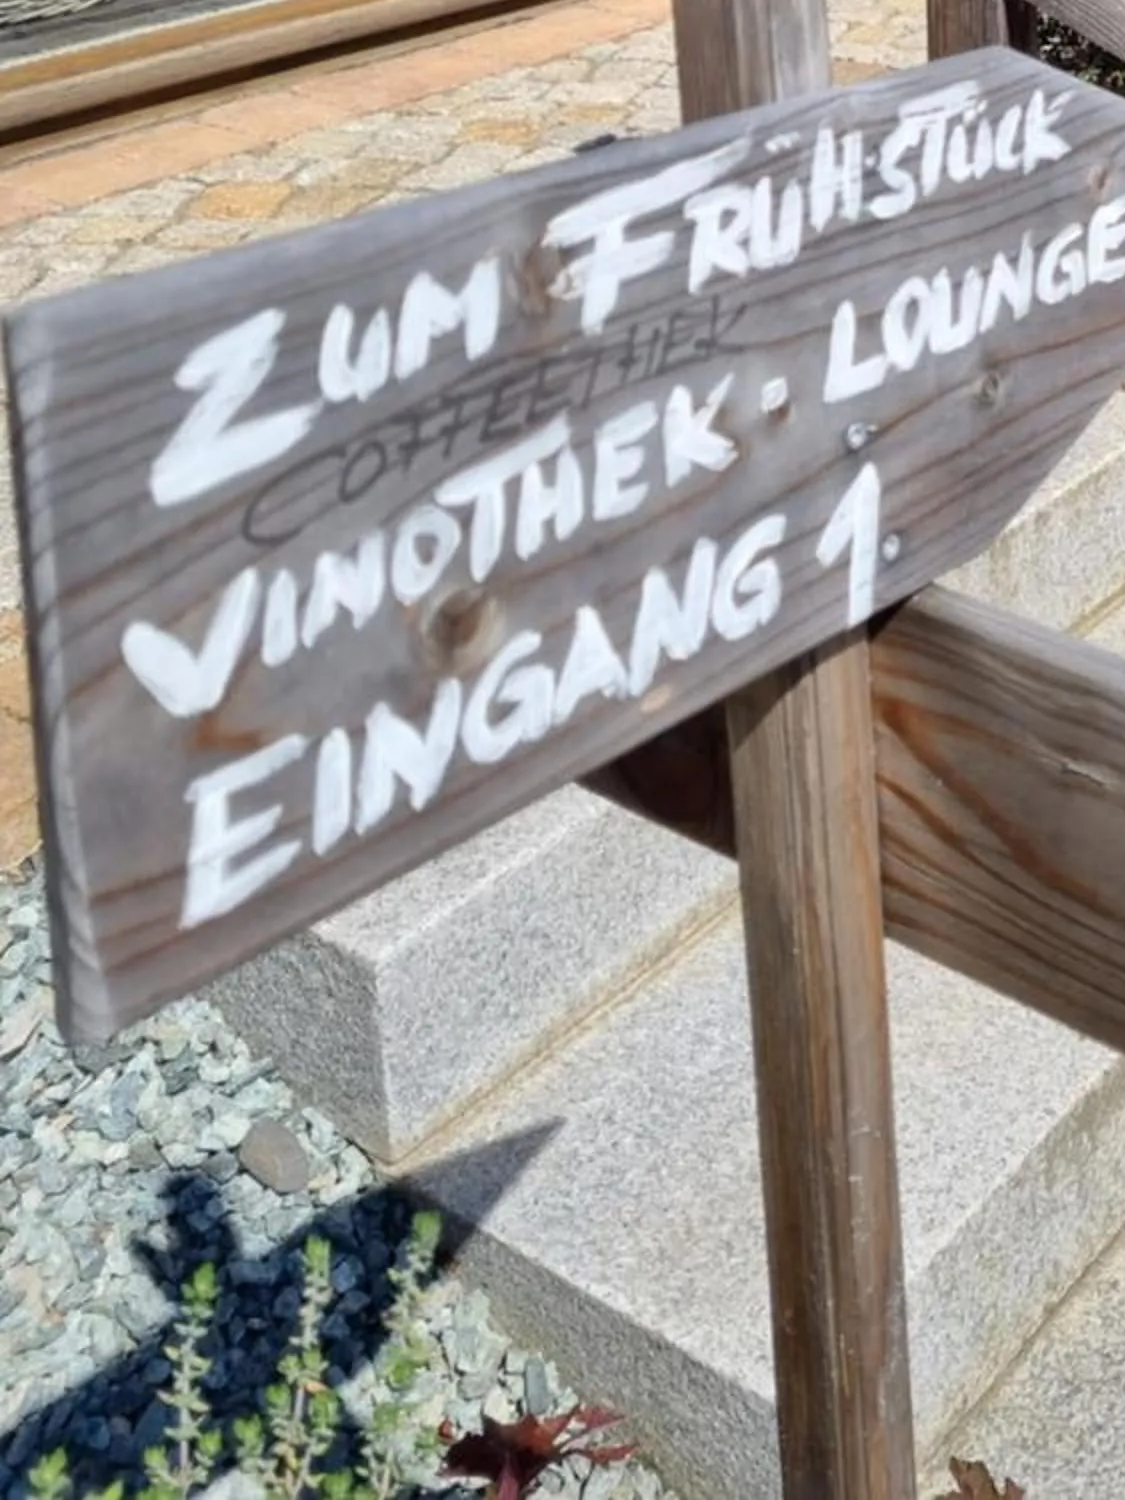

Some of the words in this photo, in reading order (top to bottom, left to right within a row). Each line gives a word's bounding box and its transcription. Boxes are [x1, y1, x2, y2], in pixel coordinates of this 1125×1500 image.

[150, 255, 500, 507] ZUM
[543, 80, 1076, 333] FRÜHSTÜCK
[121, 371, 739, 717] VINOTHEK
[178, 513, 788, 930] EINGANG
[815, 460, 882, 629] 1
